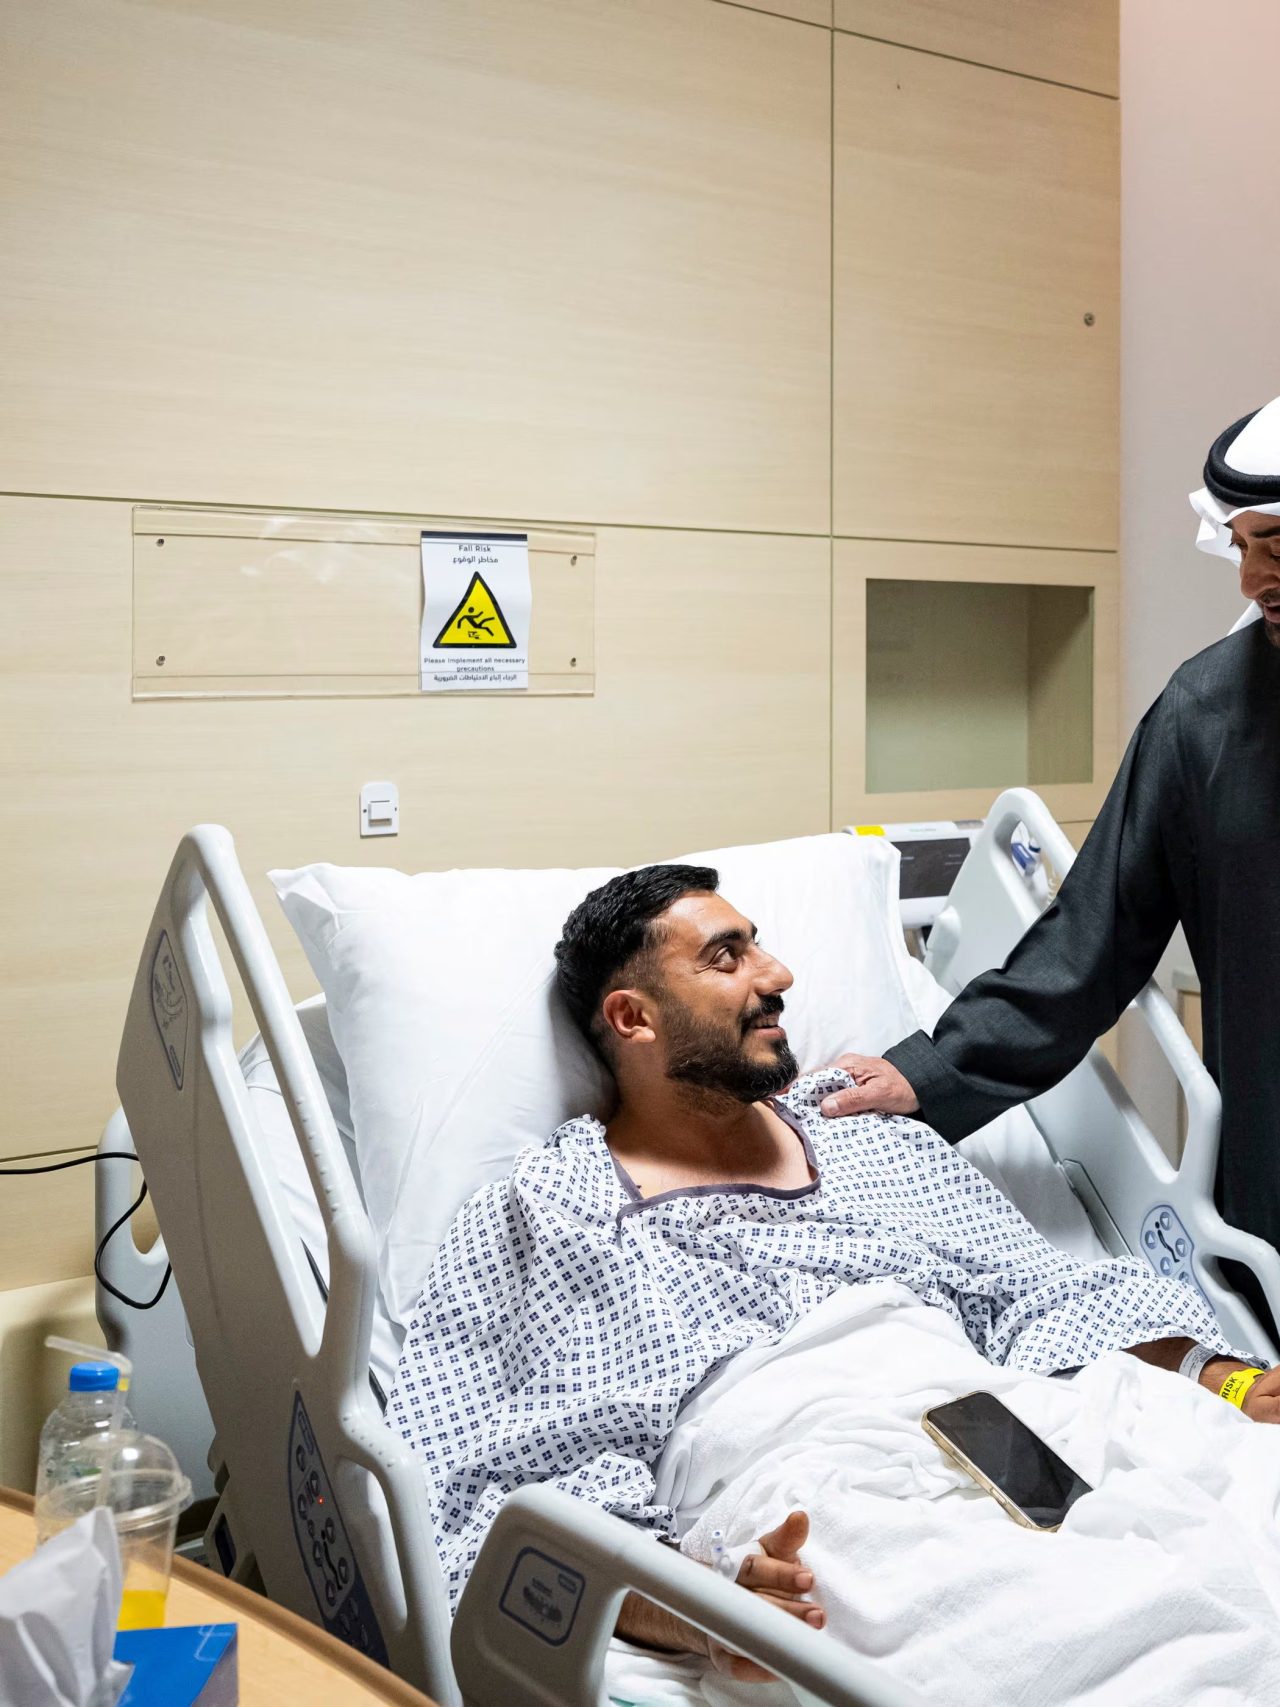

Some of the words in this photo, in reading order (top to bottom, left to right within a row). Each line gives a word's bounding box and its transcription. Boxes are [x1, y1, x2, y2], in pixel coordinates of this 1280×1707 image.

[458, 544, 473, 552] Fall
[475, 544, 491, 552] Risk
[452, 556, 476, 564] الوقوع
[477, 556, 498, 564] مخاطر
[433, 674, 458, 682] الضرورية
[1221, 1377, 1238, 1399] RISK
